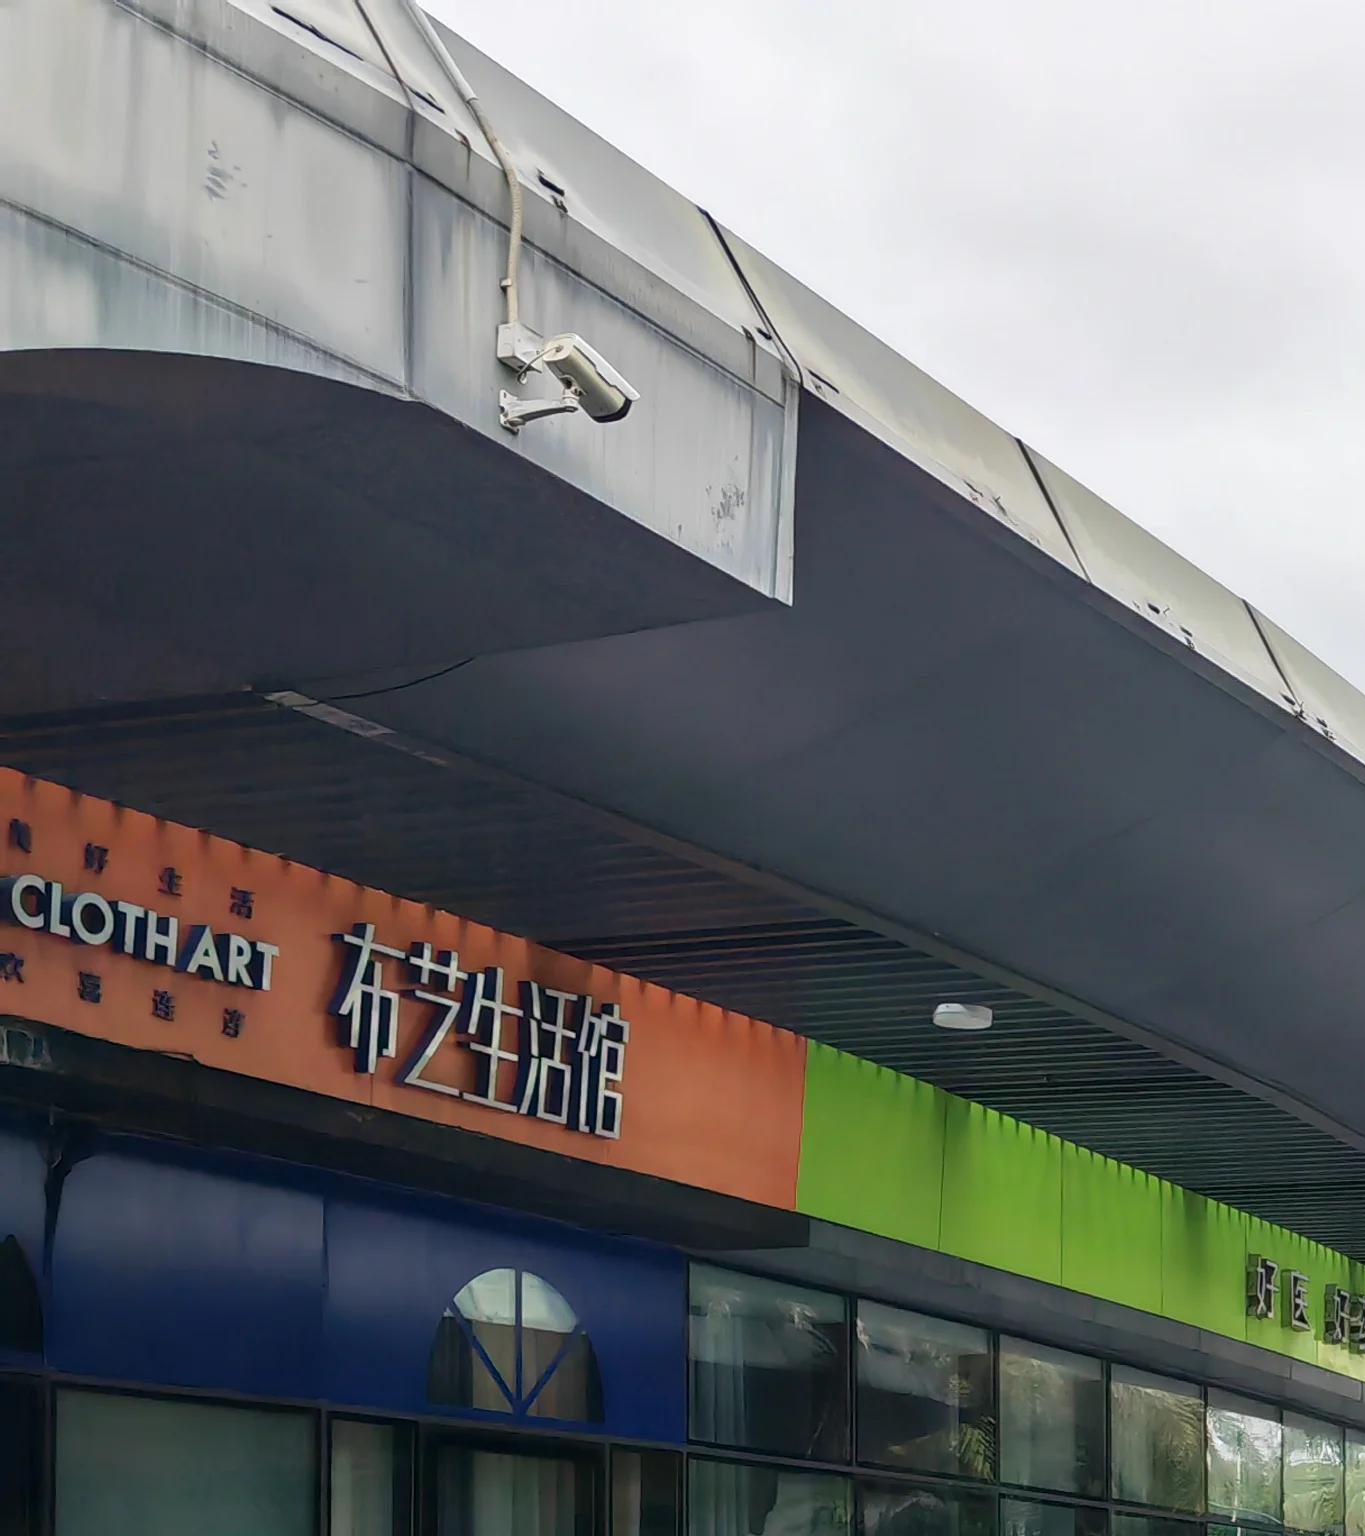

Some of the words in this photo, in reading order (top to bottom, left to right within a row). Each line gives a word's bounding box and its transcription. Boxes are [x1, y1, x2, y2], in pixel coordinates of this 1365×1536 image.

[11, 874, 178, 966] CLOTH
[187, 925, 280, 991] ART
[337, 923, 630, 1140] 布艺生活馆
